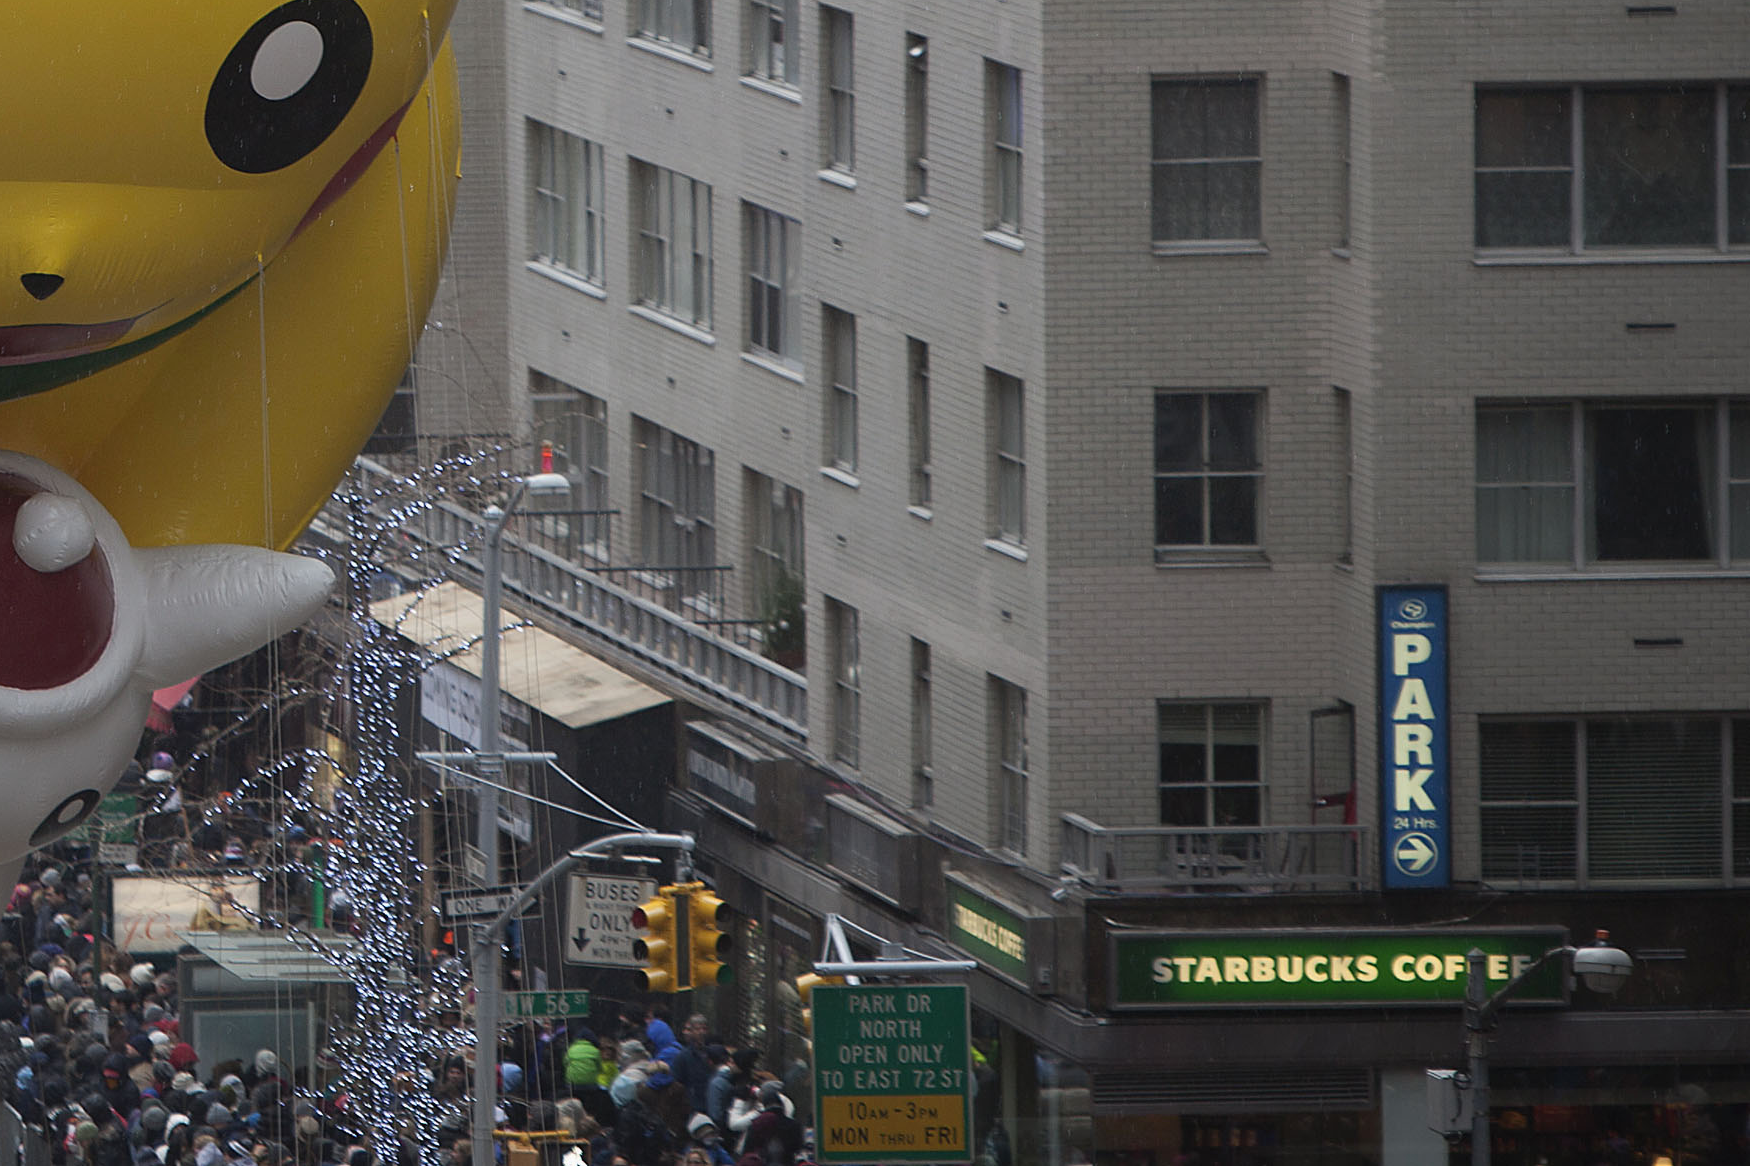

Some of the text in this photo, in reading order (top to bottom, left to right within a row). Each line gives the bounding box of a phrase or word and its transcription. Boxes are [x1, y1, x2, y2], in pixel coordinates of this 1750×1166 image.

[1392, 633, 1437, 812] PARK
[1394, 817, 1409, 830] 24
[586, 882, 640, 902] BUSES
[455, 898, 483, 913] ONE
[590, 913, 632, 932] ONLY
[1152, 954, 1533, 984] STARBUCKS COFEE
[546, 994, 570, 1014] 56
[574, 994, 586, 1005] ST
[849, 994, 932, 1014] PARK DR
[860, 1020, 922, 1038] NORTH
[839, 1044, 944, 1064] OPEN ONLY
[821, 1069, 963, 1089] TO EAST 72 ST
[830, 1126, 958, 1145] MON THRU FRI
